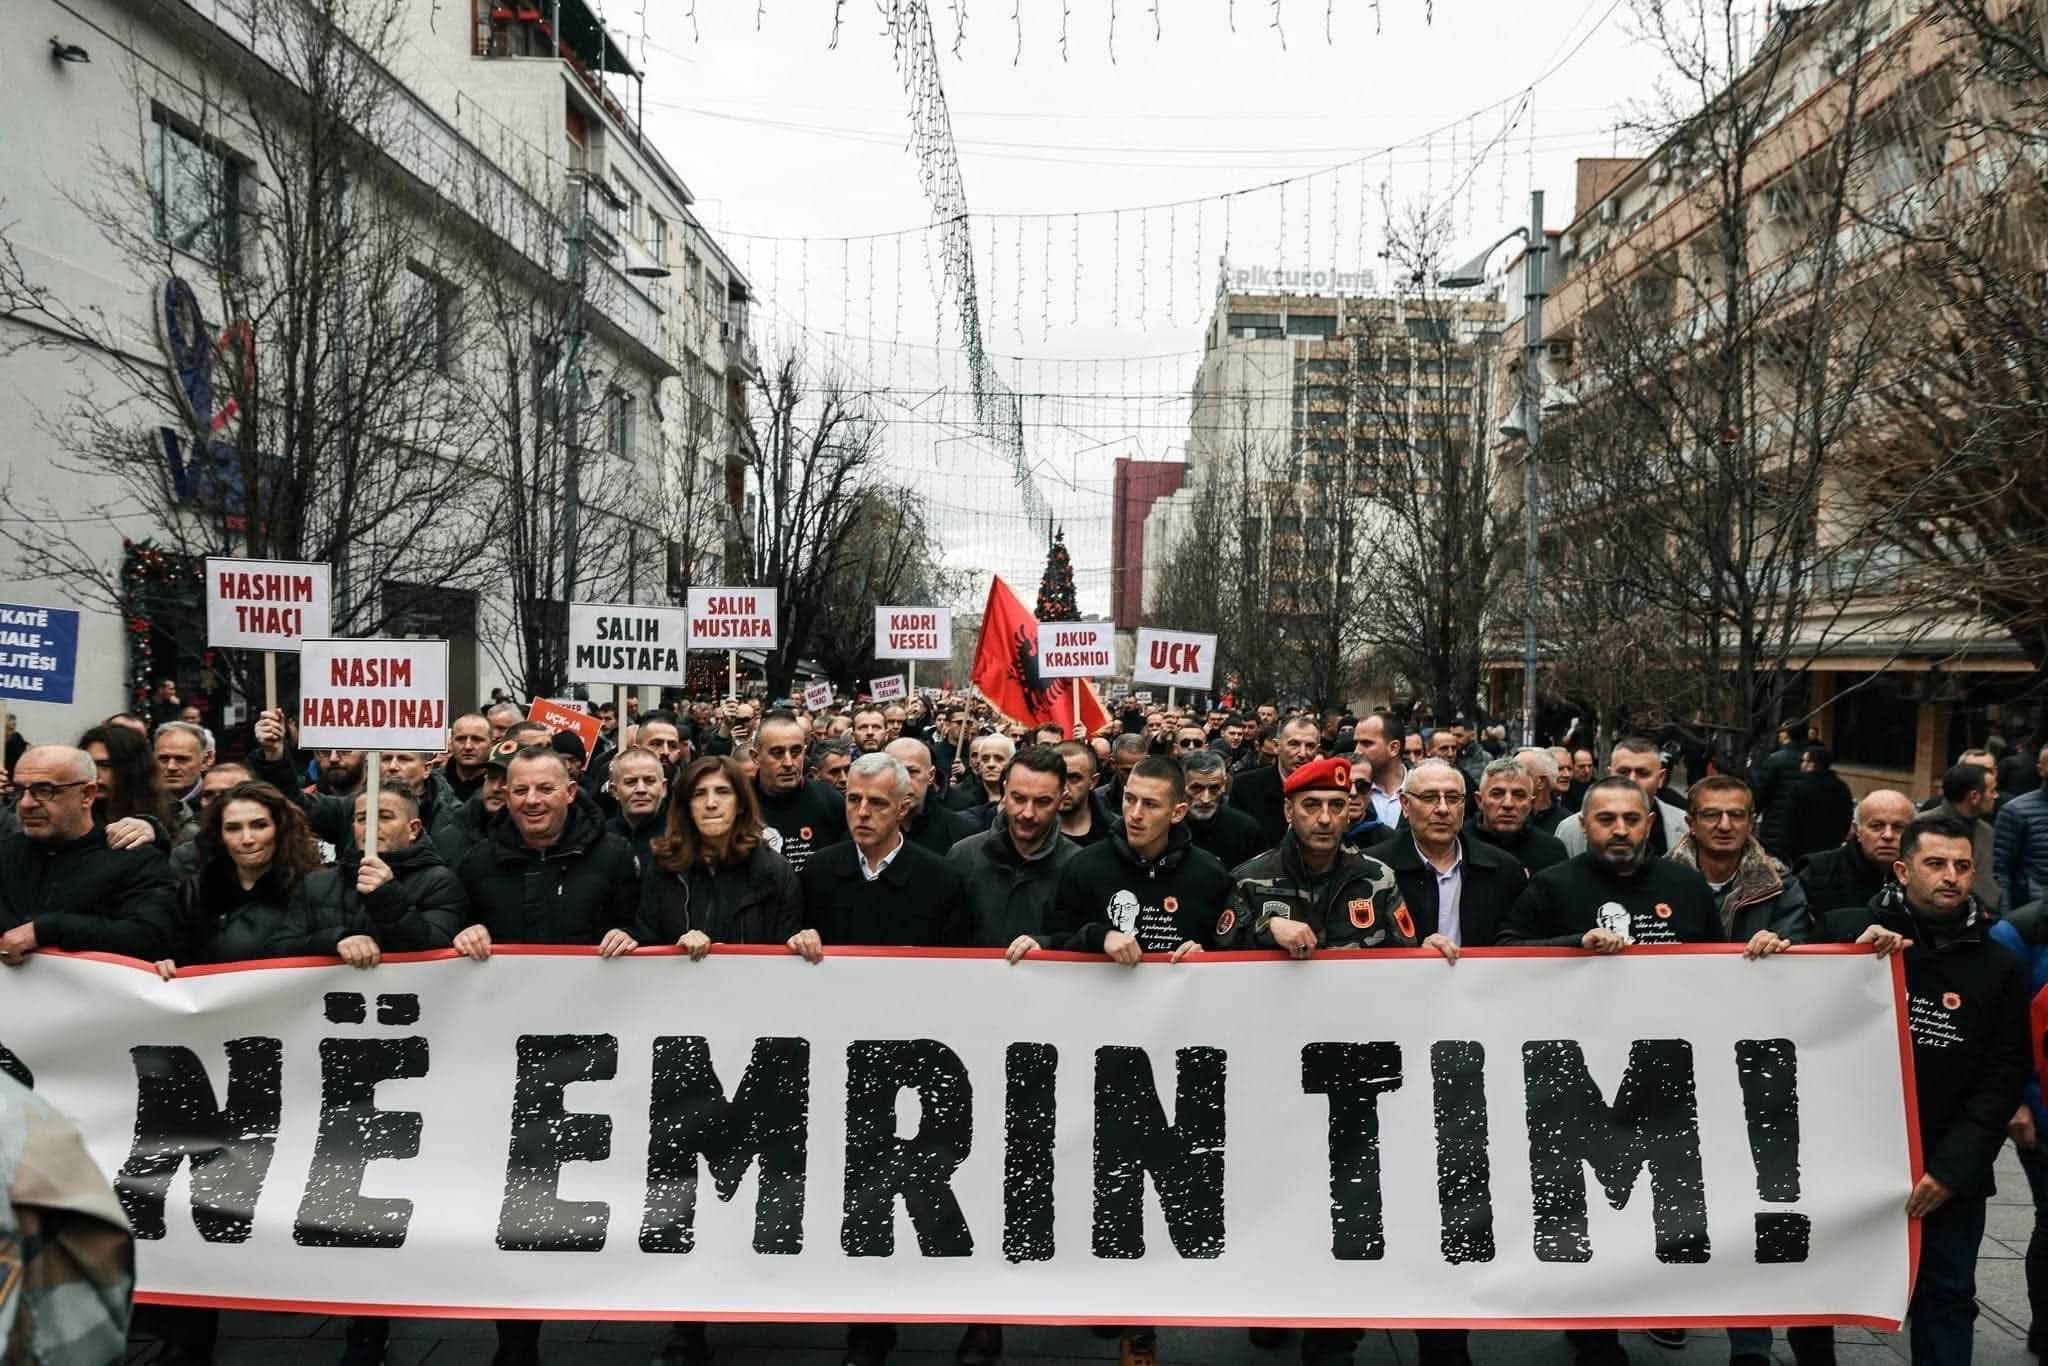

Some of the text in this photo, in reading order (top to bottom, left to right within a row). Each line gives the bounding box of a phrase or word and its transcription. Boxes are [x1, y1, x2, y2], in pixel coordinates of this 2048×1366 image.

[220, 573, 312, 602] HASHIM
[708, 597, 755, 614] SALIH
[0, 608, 48, 628] KATË
[236, 606, 301, 637] THAÇI
[597, 617, 658, 641] SALIH
[694, 619, 771, 637] MUSTAFA
[891, 615, 935, 630] KADRI
[889, 634, 937, 649] VESELI
[1056, 632, 1096, 646] JAKUP
[577, 645, 678, 671] MUSTAFA
[1046, 651, 1108, 667] KRASNIQI
[1151, 641, 1200, 674] UÇK
[332, 658, 410, 687] NASIM
[304, 698, 443, 728] HARADINAJ
[113, 992, 1812, 1266] NË EMRIN TIM!
